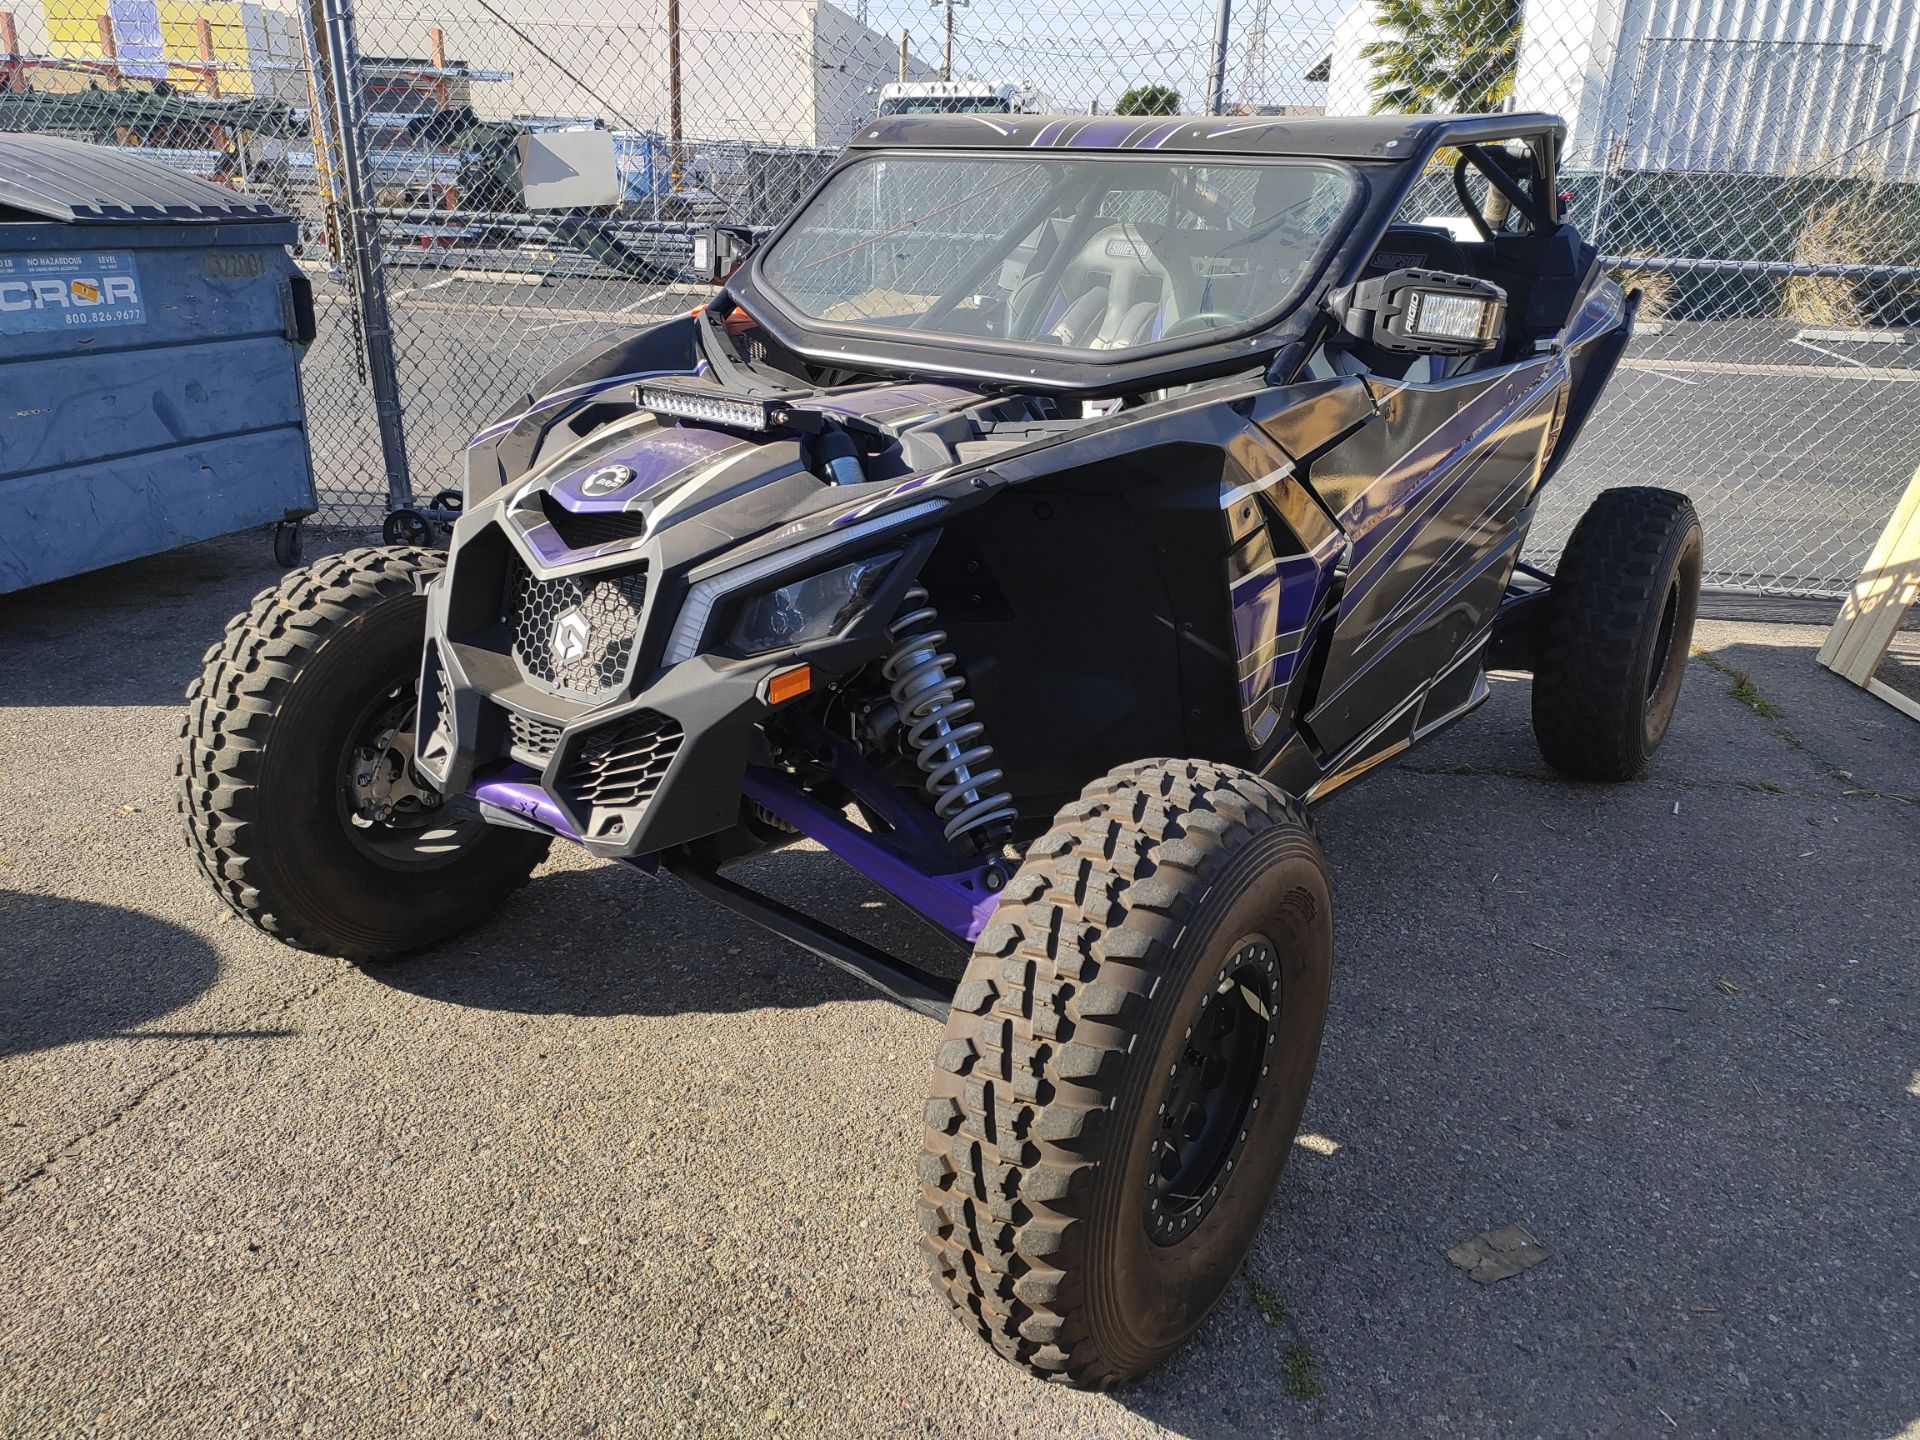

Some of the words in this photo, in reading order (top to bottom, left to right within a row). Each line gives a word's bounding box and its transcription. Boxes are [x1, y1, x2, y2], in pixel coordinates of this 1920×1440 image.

[26, 258, 38, 267] NO
[40, 256, 82, 266] HAZARDOUS
[98, 255, 117, 264] LEVEL
[1373, 253, 1424, 268] SIMPSON
[65, 310, 140, 324] 800.826.9677
[1404, 292, 1420, 334] RIGID
[596, 478, 618, 488] BRP
